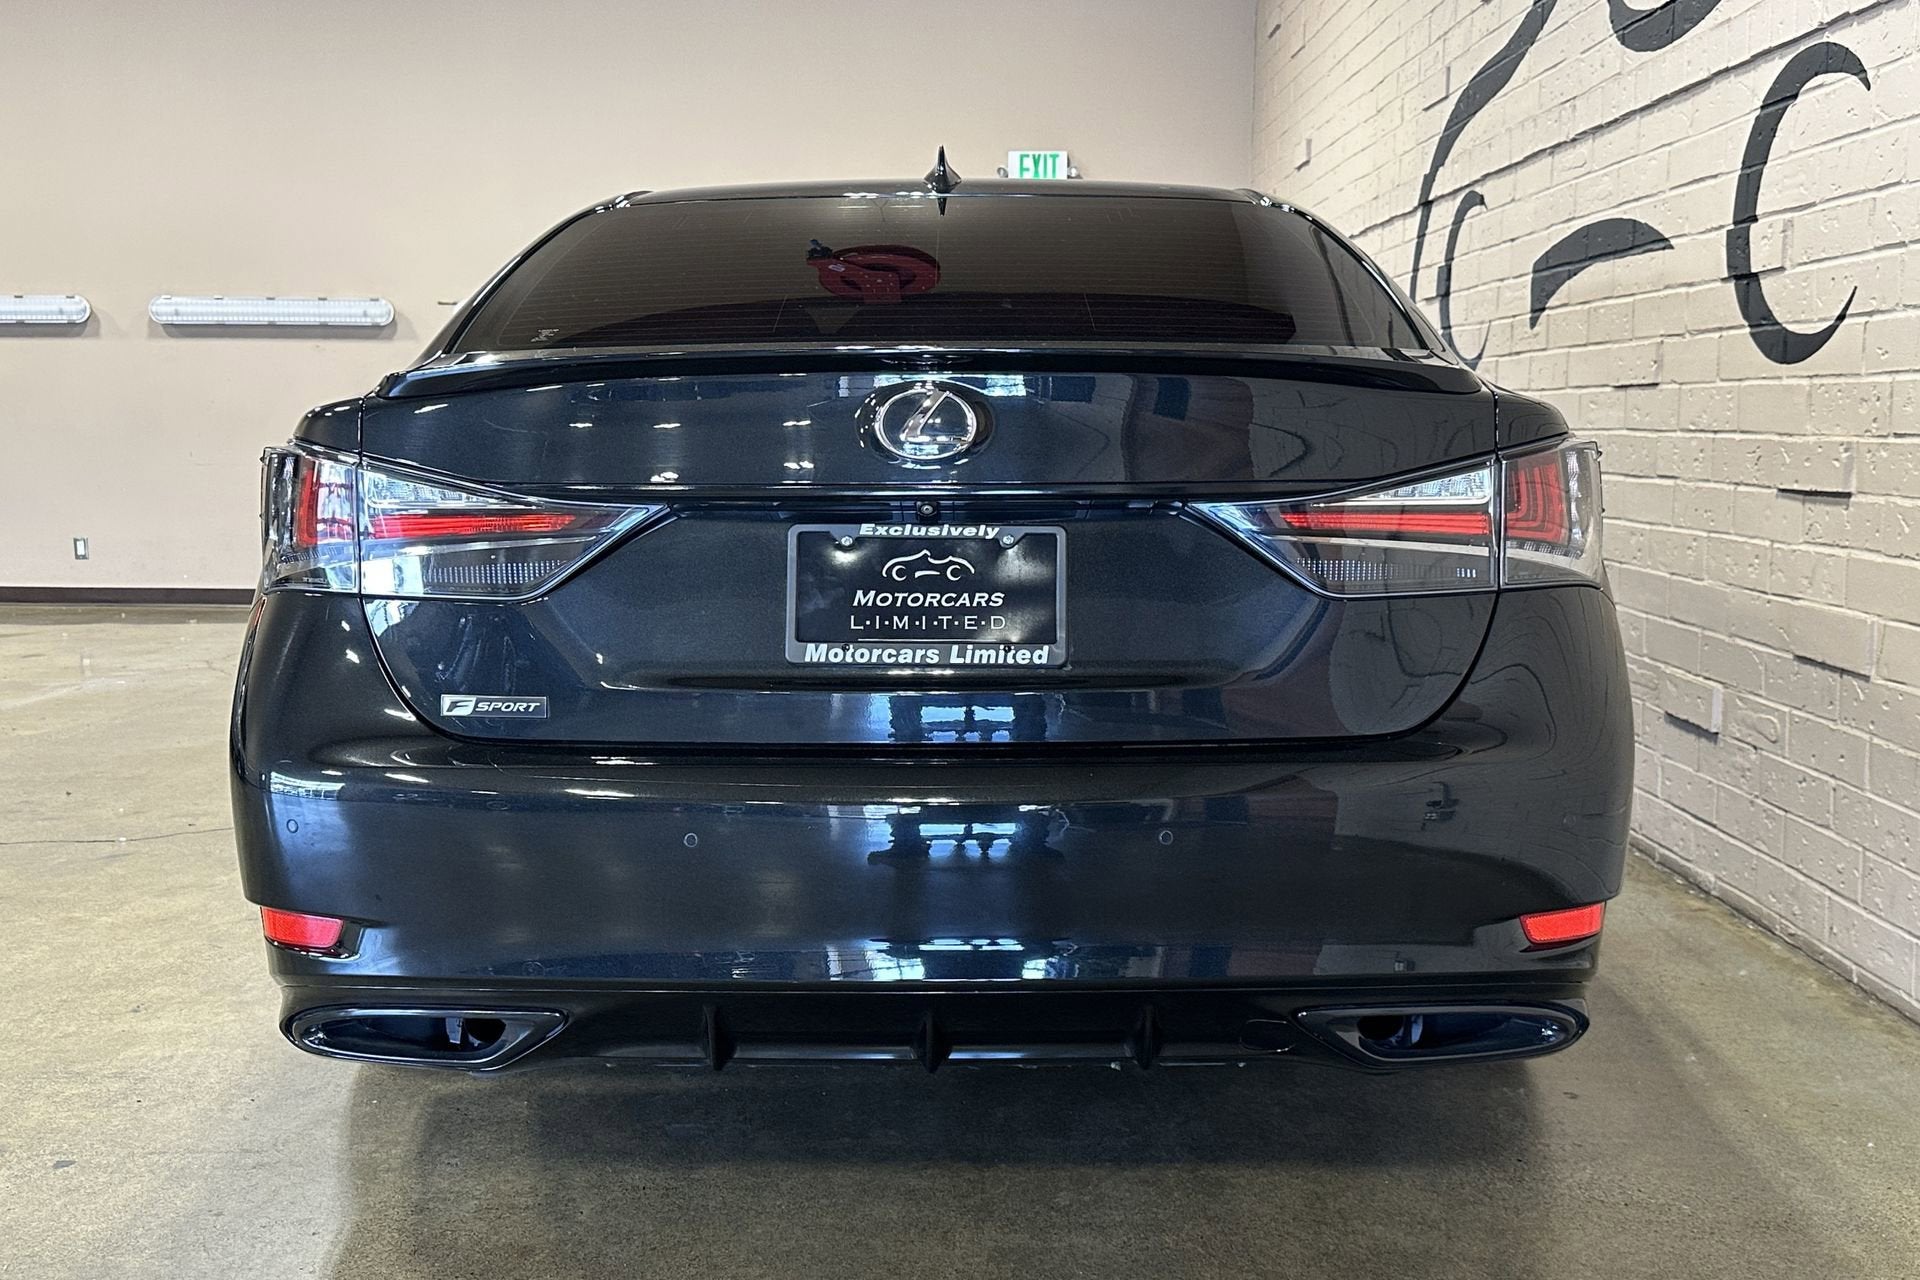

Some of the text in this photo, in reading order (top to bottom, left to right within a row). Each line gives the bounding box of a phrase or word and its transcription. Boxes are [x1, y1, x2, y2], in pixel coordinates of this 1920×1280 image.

[1019, 153, 1060, 179] EXIT
[859, 523, 1000, 539] Exclusively
[852, 589, 1006, 607] MOTORCARS
[804, 643, 1050, 664] Motorcars Limited
[475, 702, 541, 713] SPORT
